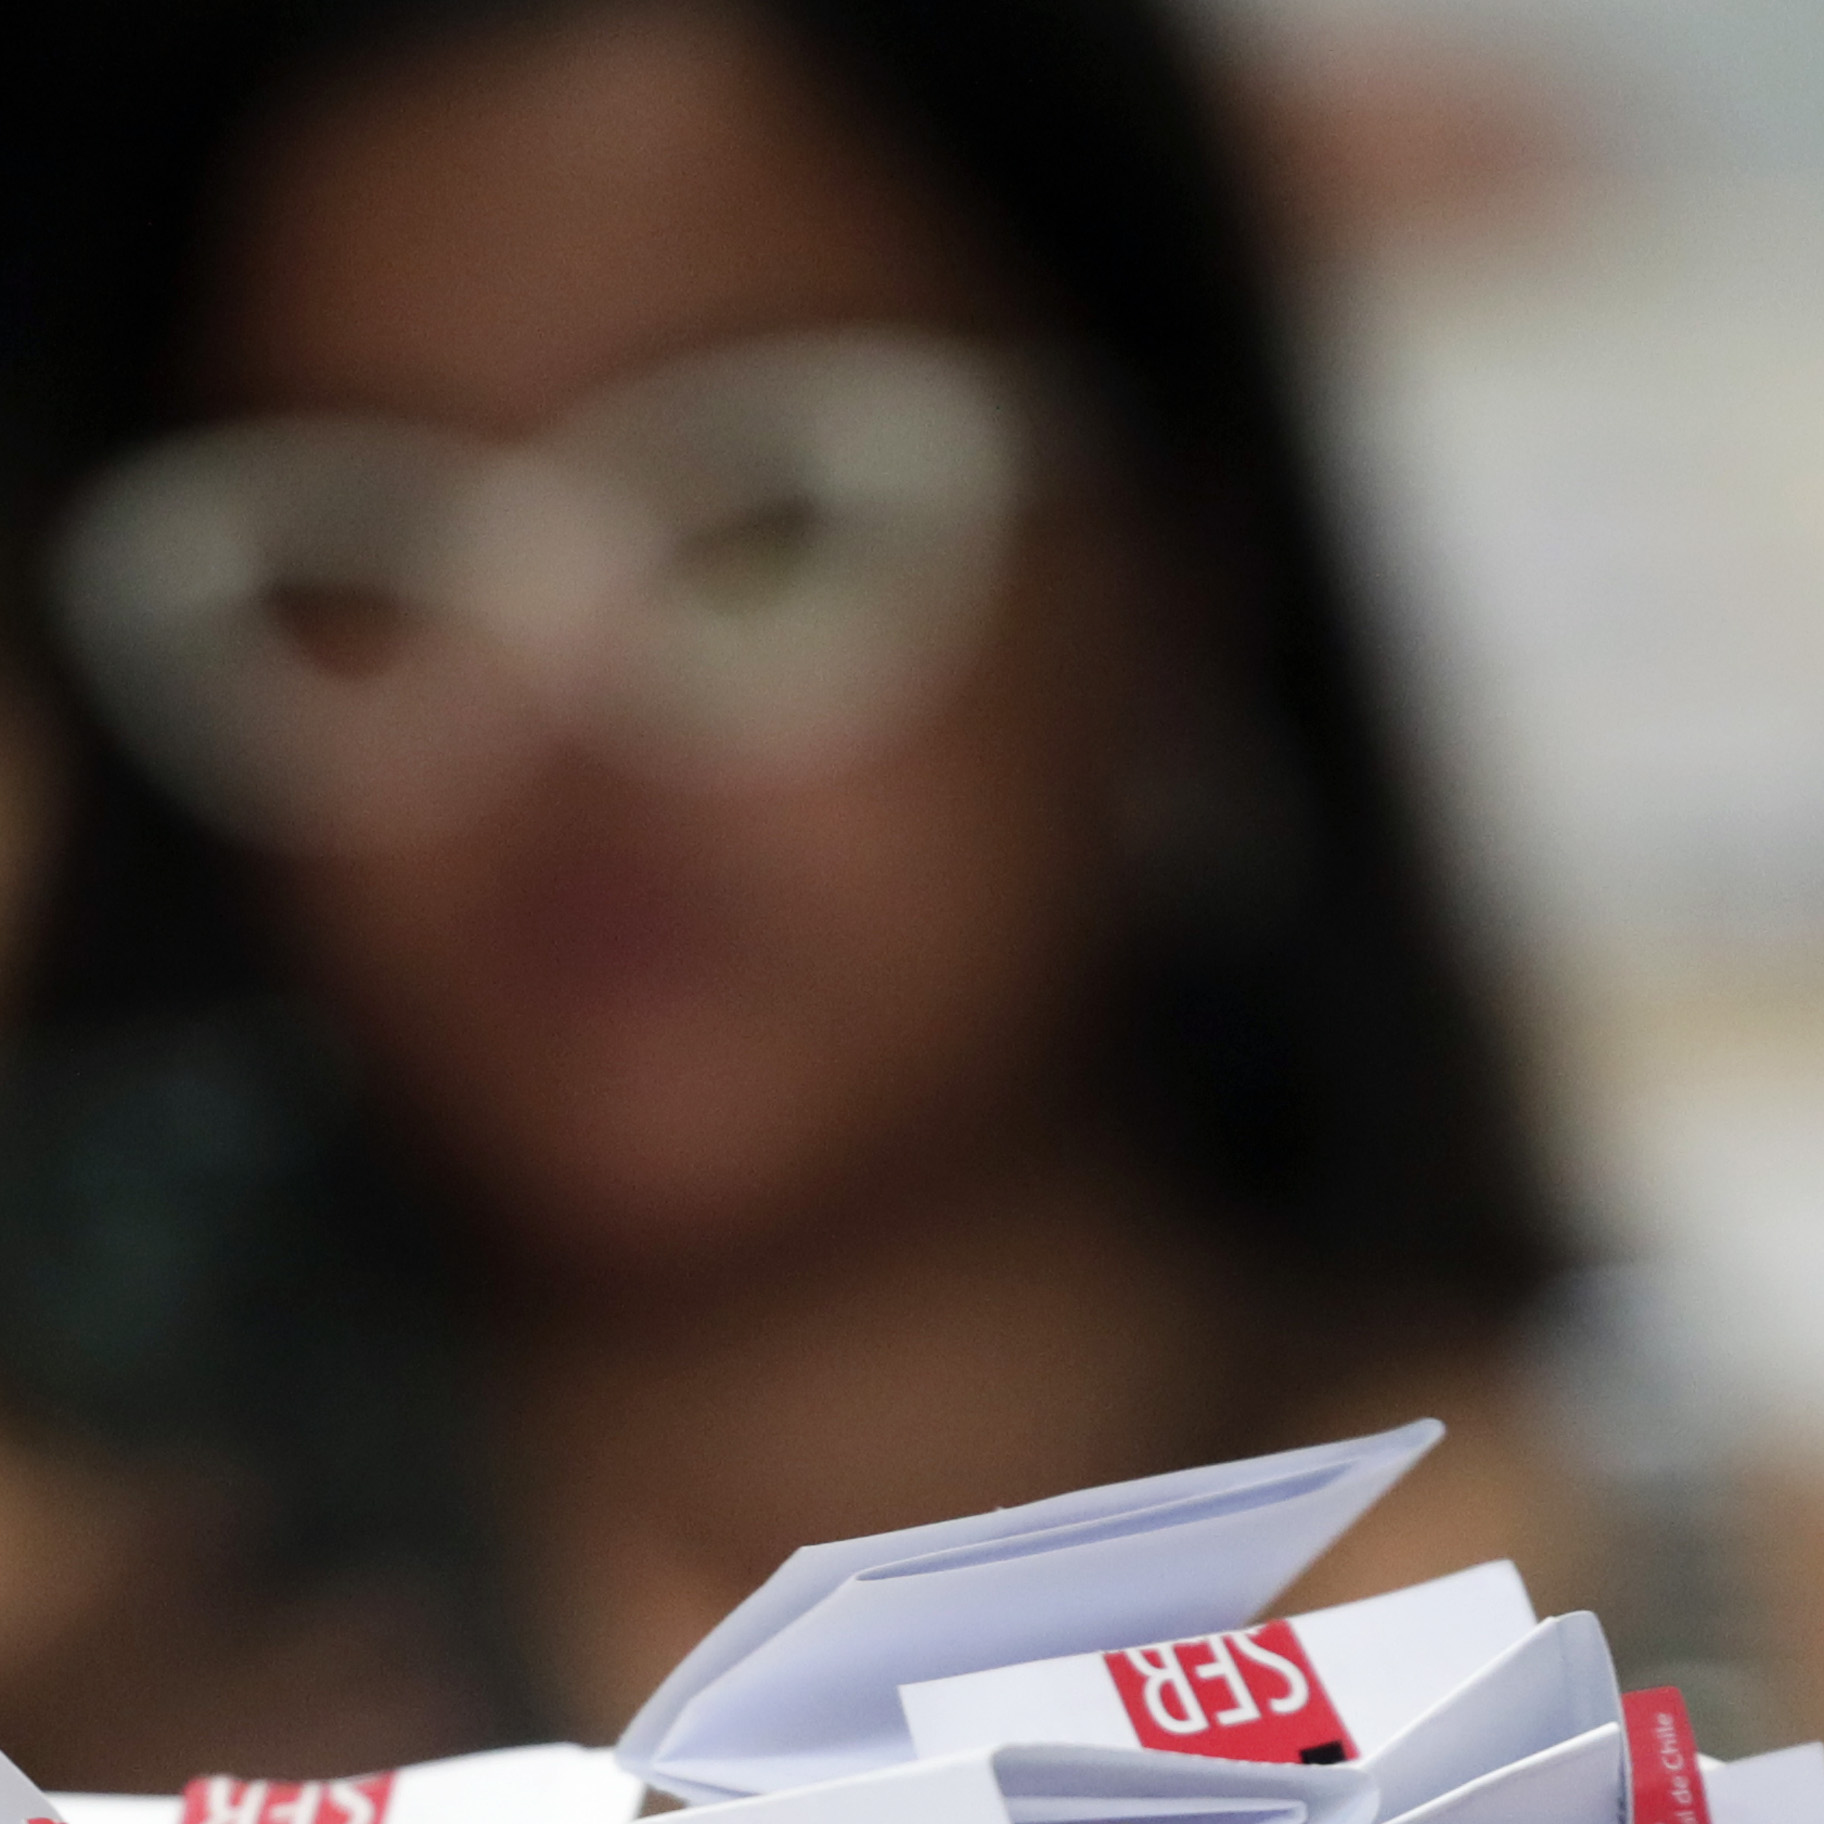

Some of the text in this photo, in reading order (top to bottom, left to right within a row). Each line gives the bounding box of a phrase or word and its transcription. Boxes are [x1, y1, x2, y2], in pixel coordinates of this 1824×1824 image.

[1127, 1628, 1309, 1735] SER
[1656, 1712, 1685, 1771] Chile
[1672, 1775, 1693, 1805] de
